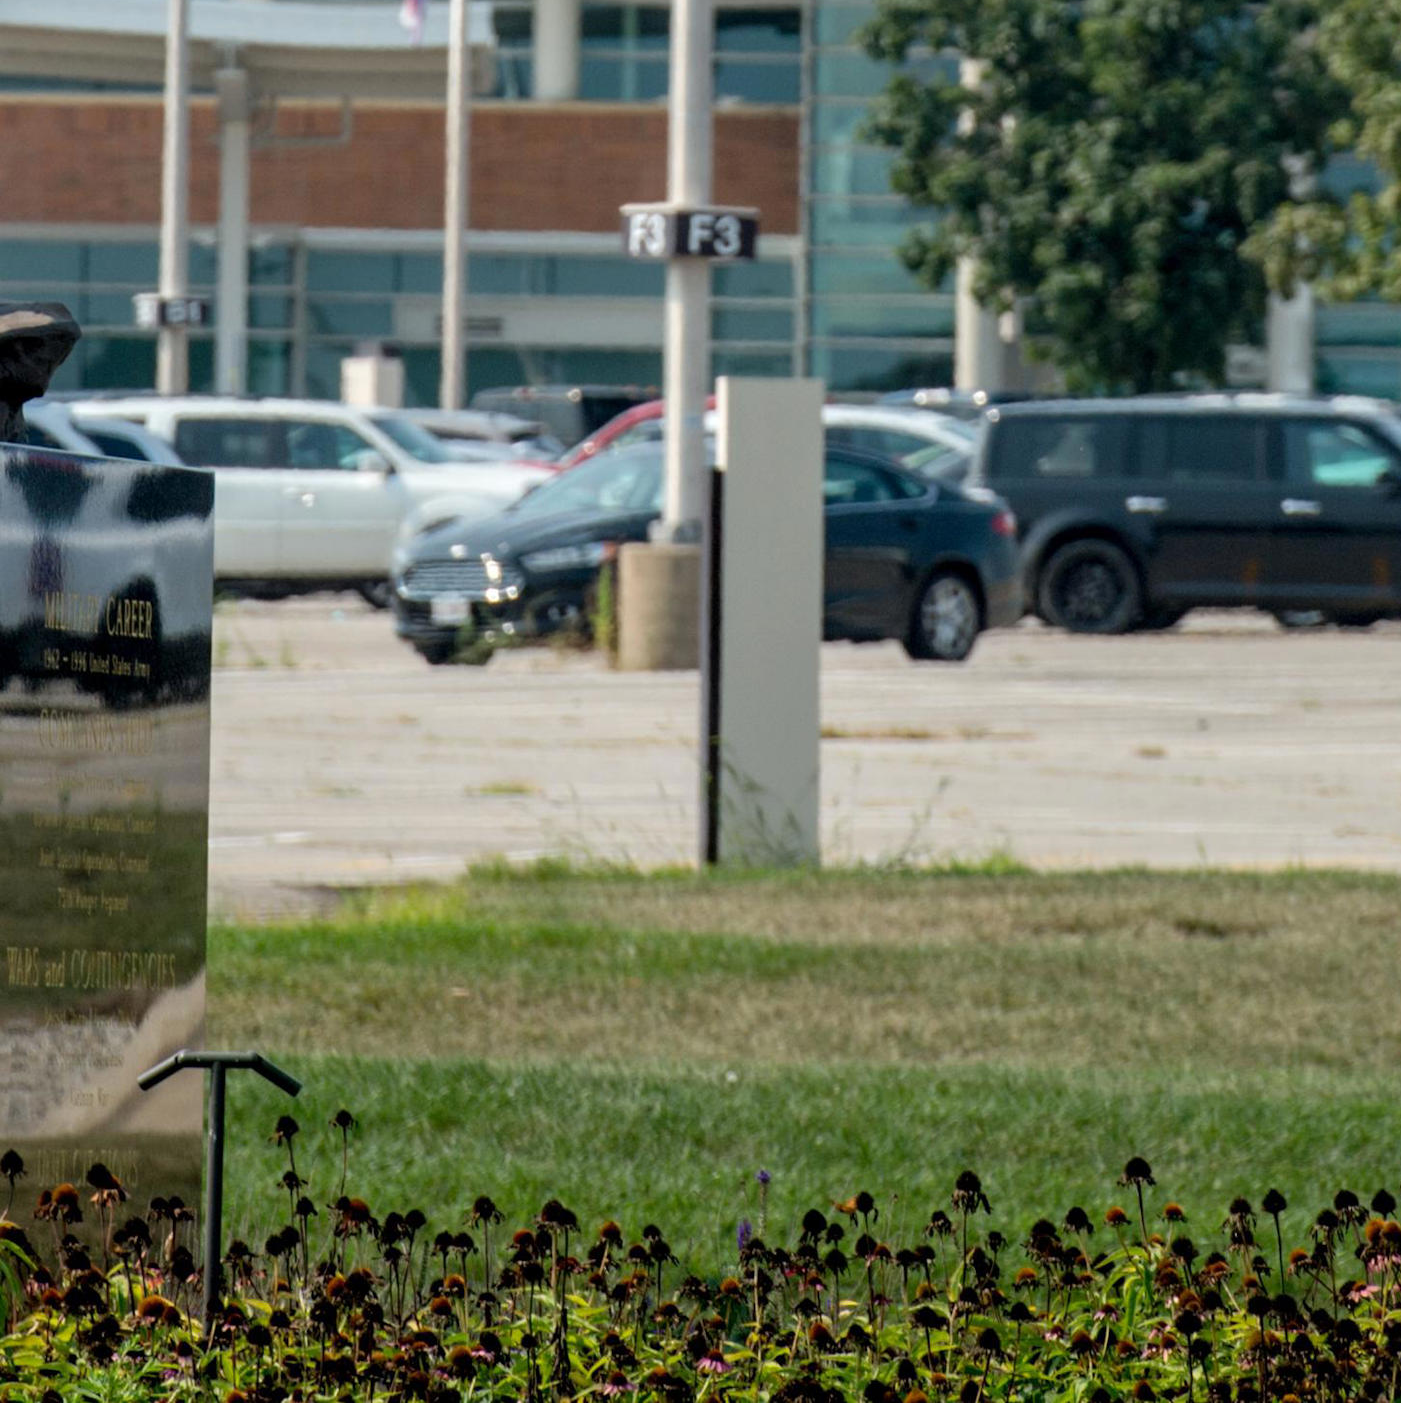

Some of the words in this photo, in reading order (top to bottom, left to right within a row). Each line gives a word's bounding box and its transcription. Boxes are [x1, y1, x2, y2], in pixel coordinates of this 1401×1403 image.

[629, 213, 666, 256] F3
[688, 213, 741, 256] F3
[106, 595, 153, 639] CAREER
[7, 947, 40, 987] WARS
[45, 951, 65, 988] and
